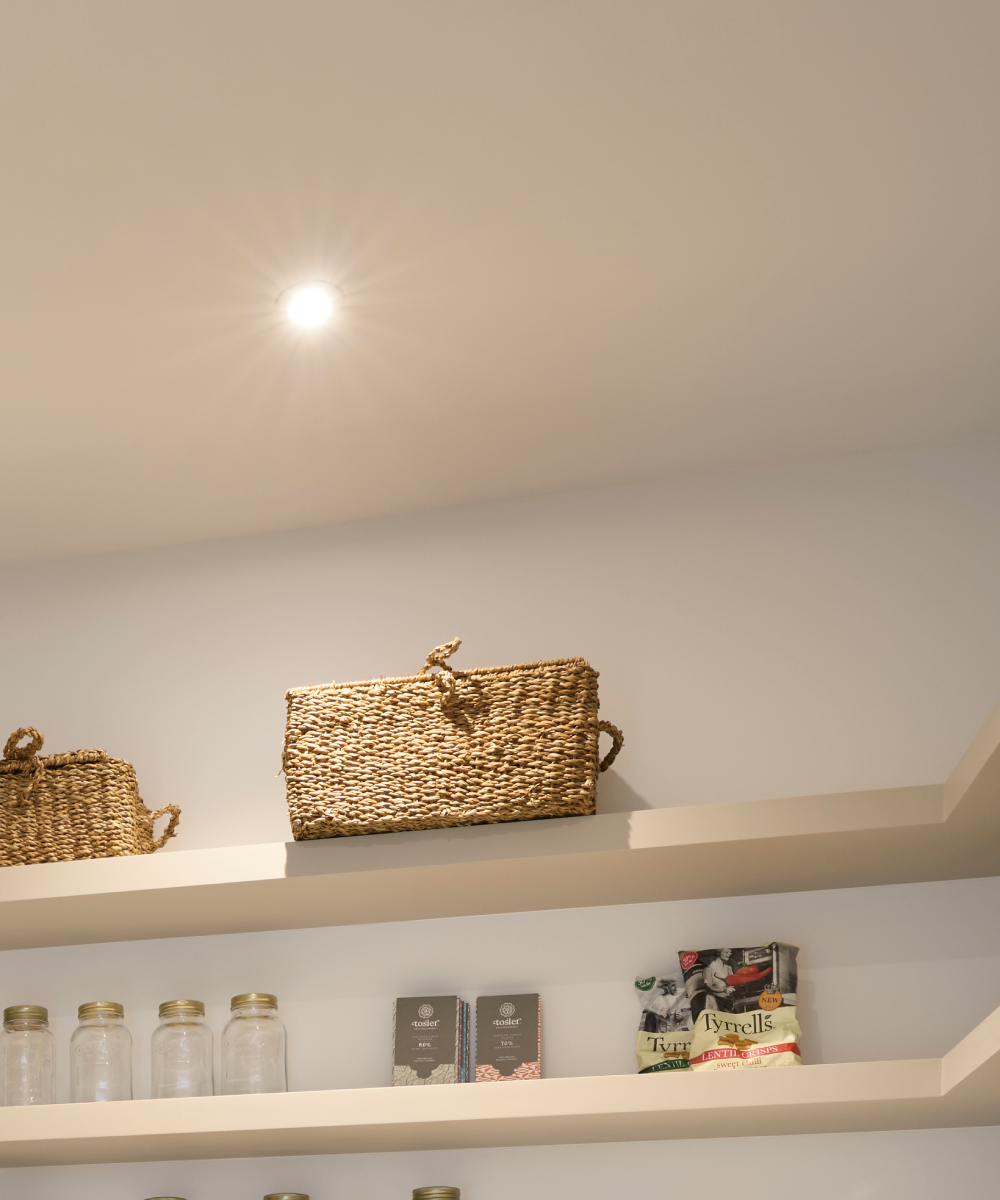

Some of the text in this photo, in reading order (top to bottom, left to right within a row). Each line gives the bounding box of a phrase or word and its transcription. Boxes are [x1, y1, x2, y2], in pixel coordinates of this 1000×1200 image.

[702, 1045, 778, 1061] LENTIL CRISPS
[717, 1061, 740, 1069] sweet
[742, 1057, 762, 1066] chilli
